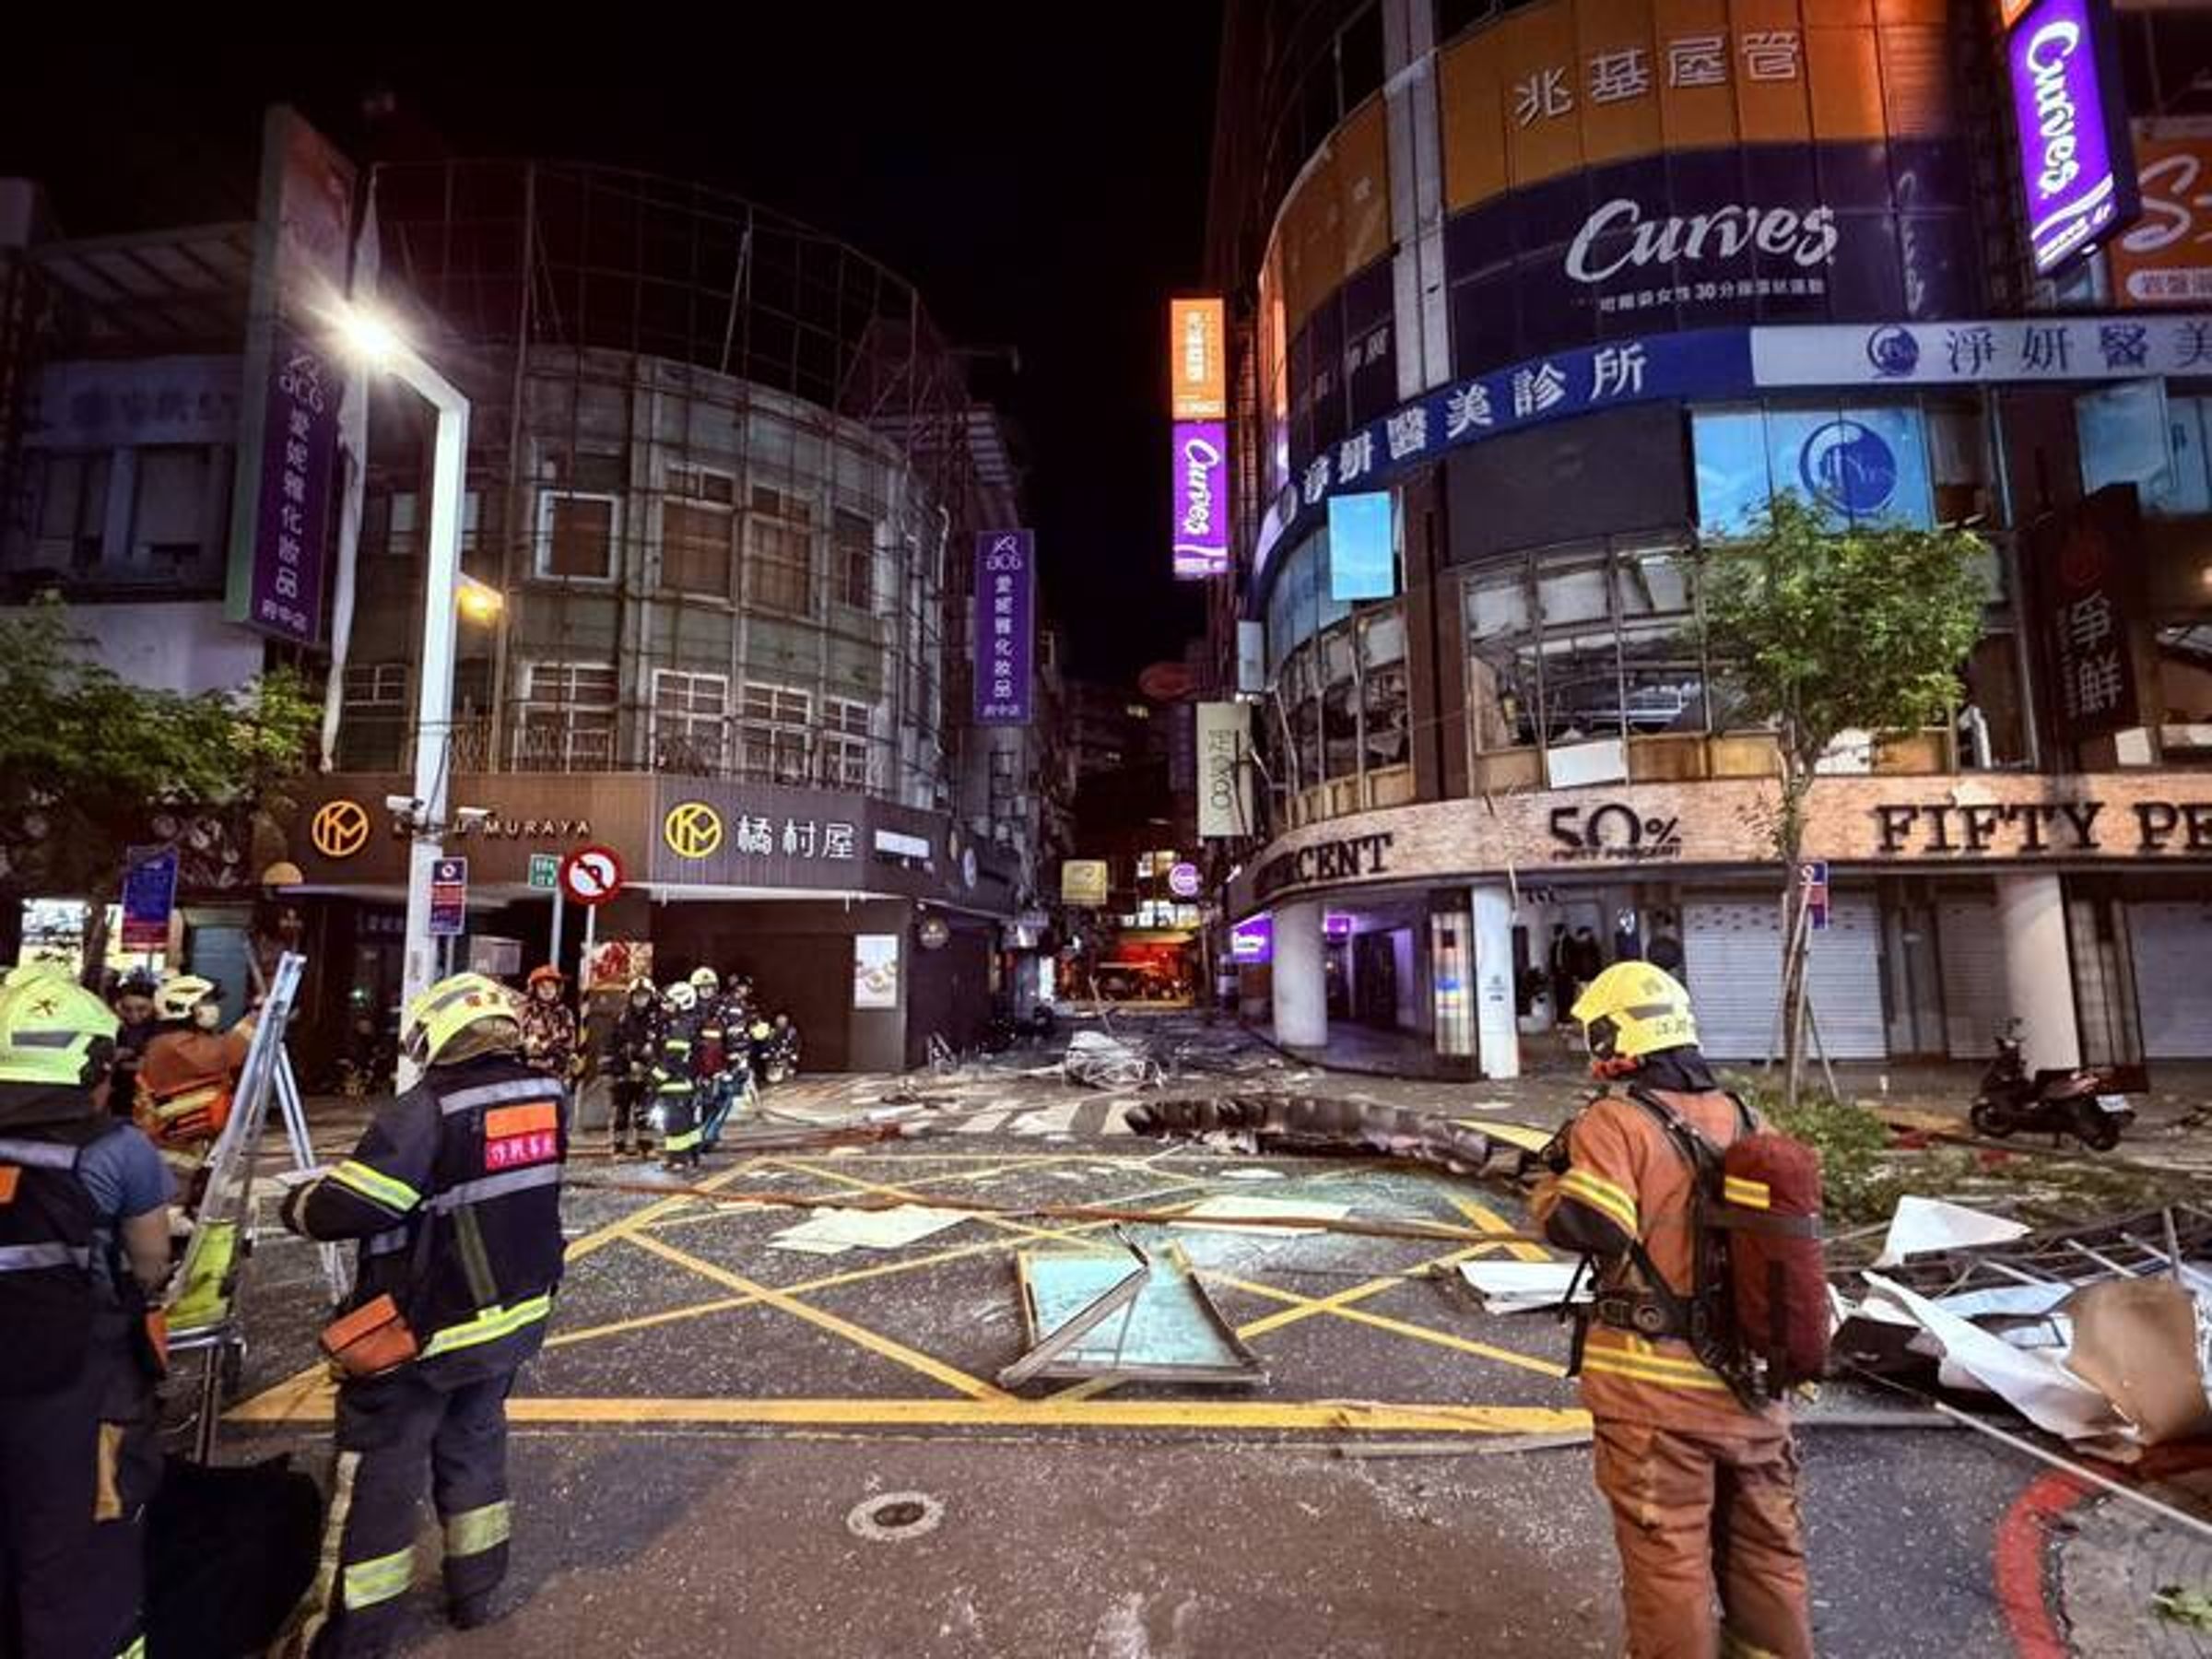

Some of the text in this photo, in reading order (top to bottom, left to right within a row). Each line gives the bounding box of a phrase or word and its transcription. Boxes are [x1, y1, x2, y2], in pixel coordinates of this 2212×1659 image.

[1515, 31, 1800, 126] 兆基屋管
[2027, 20, 2080, 199] Curves
[1565, 198, 1839, 282] Curves
[1303, 342, 1648, 504] 淨妍醫美診所
[1185, 438, 1219, 535] Curves
[2071, 588, 2122, 712] 爭鮮
[736, 814, 855, 859] 橘村屋
[1550, 804, 1681, 846] 50%
[1875, 801, 2105, 852] FIFTY
